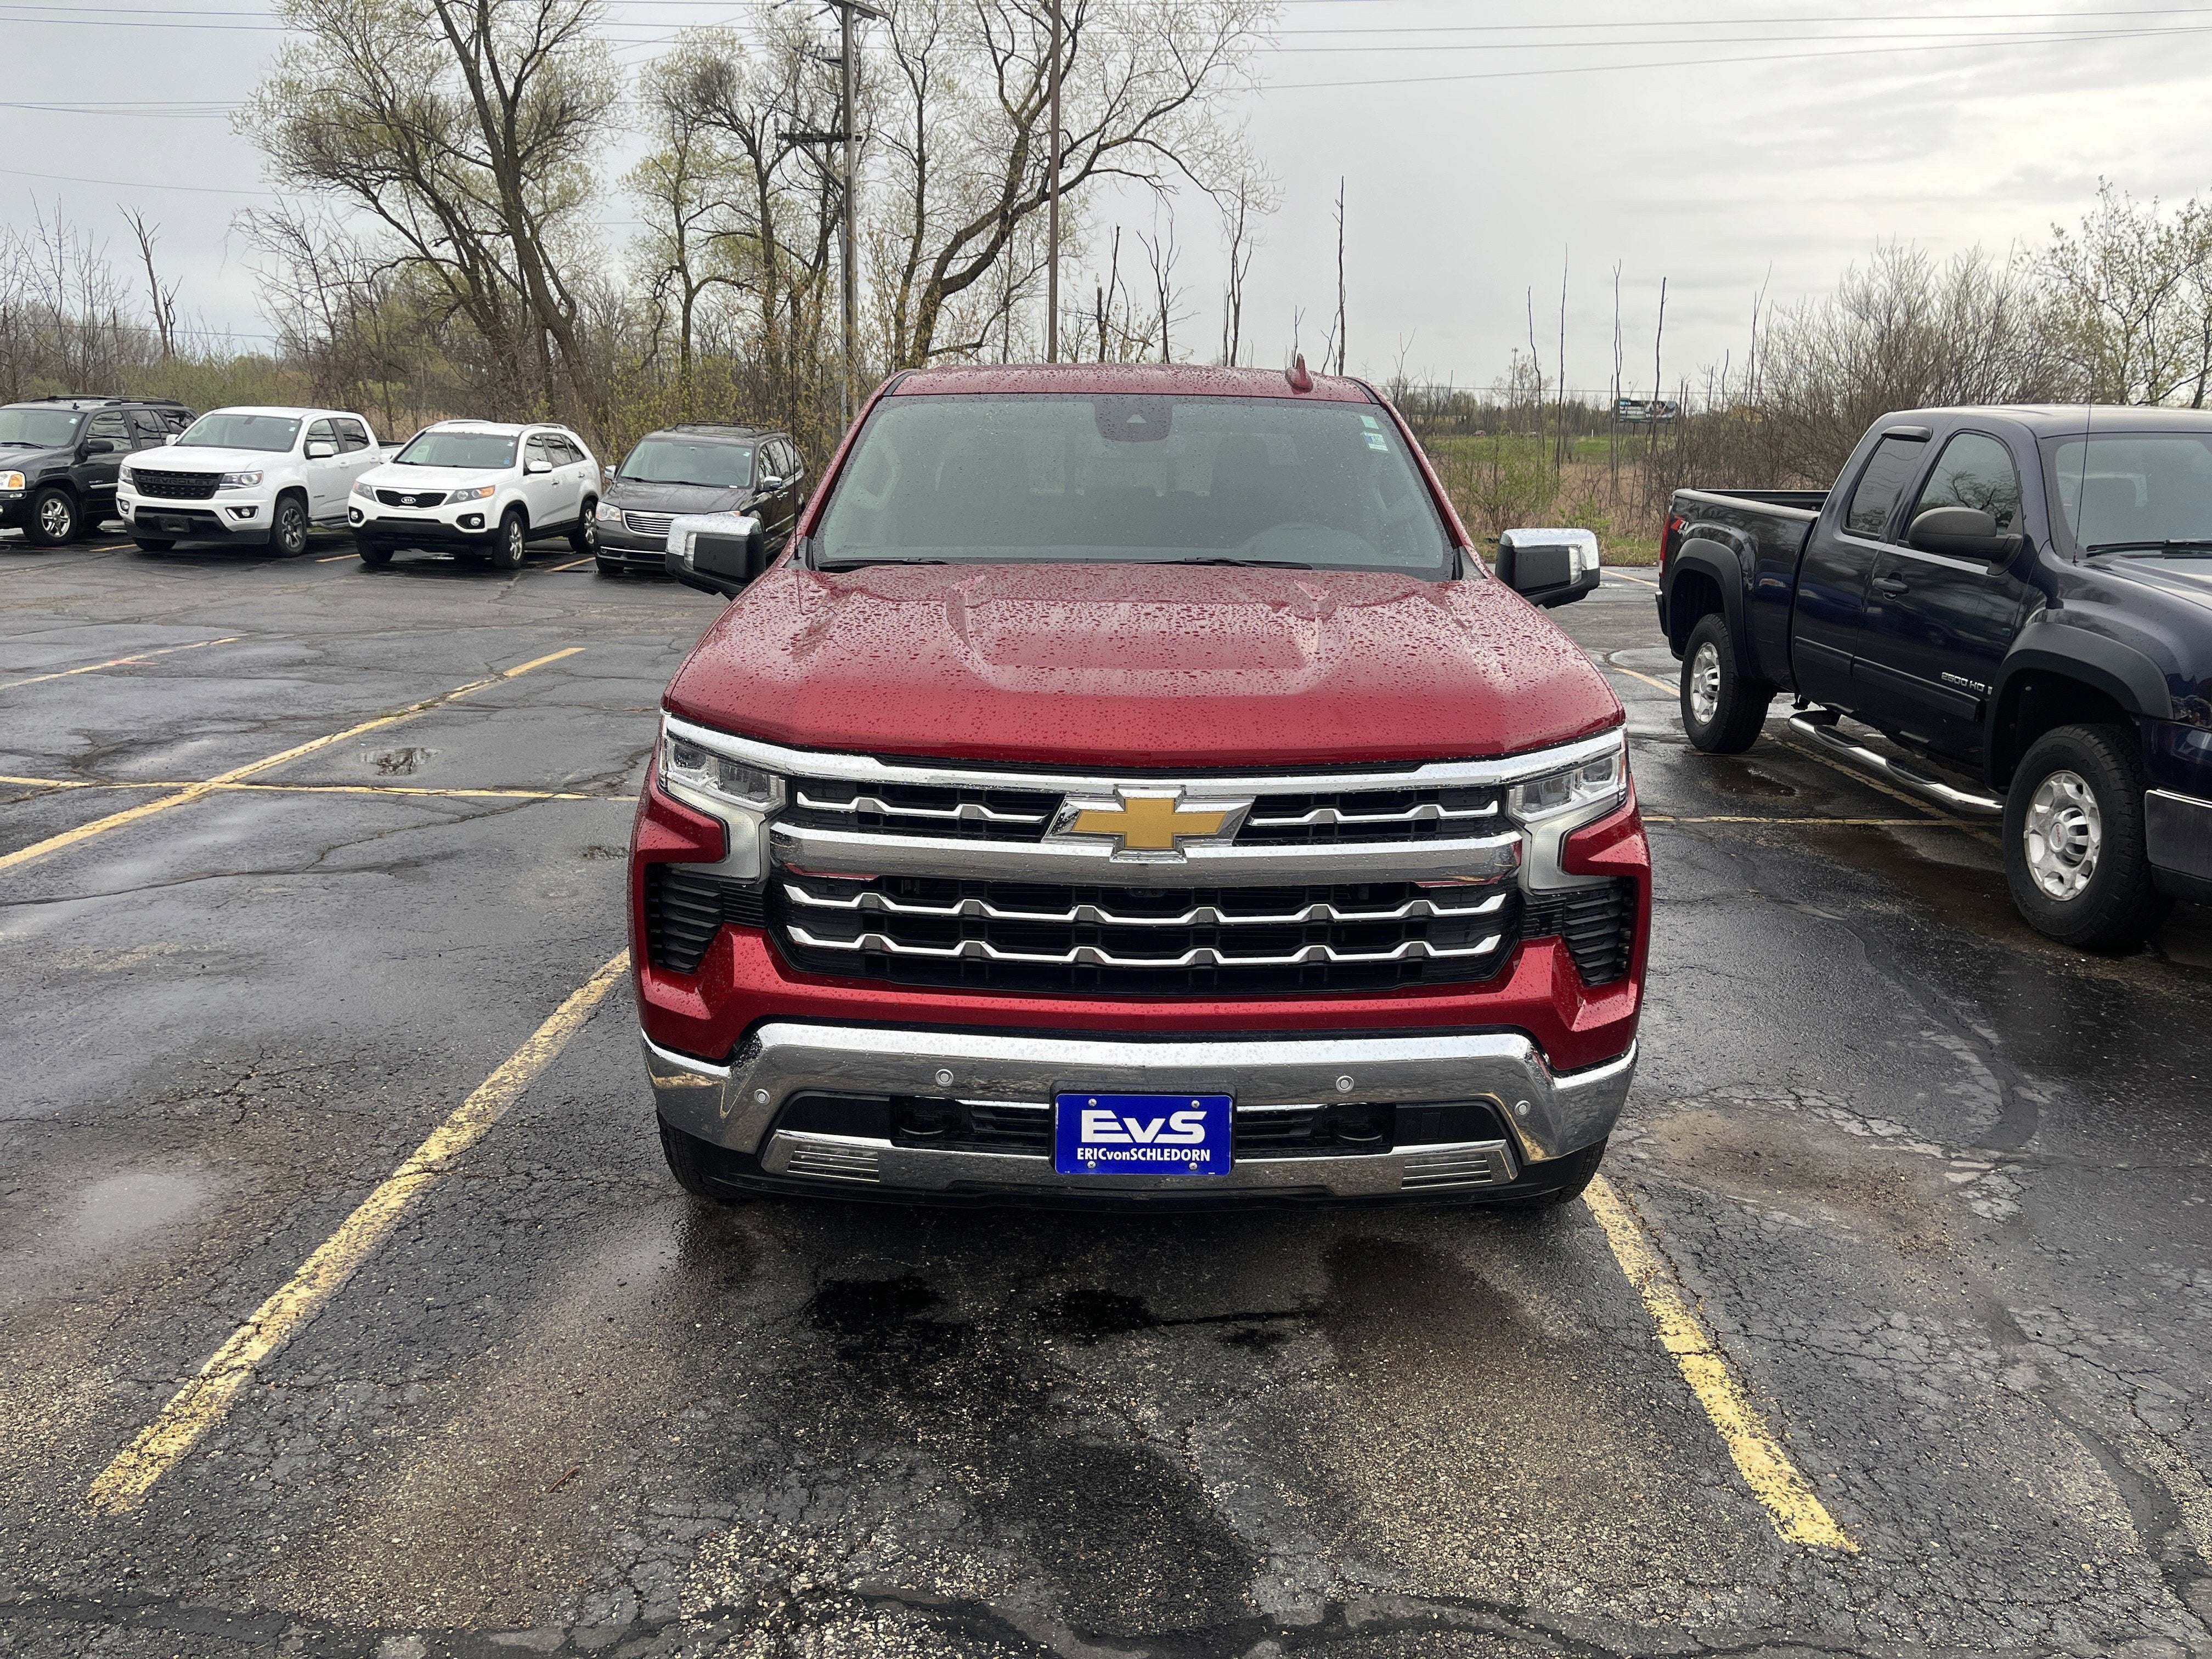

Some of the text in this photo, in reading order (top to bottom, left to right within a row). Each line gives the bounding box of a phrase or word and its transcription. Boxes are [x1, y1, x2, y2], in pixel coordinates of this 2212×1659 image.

[138, 476, 212, 486] CHEVROLET
[1671, 516, 1689, 531] Z71
[1942, 672, 1985, 692] 2500 HD
[1081, 1109, 1207, 1144] EvS
[1077, 1147, 1210, 1162] ERICvonSCHLEDORN
